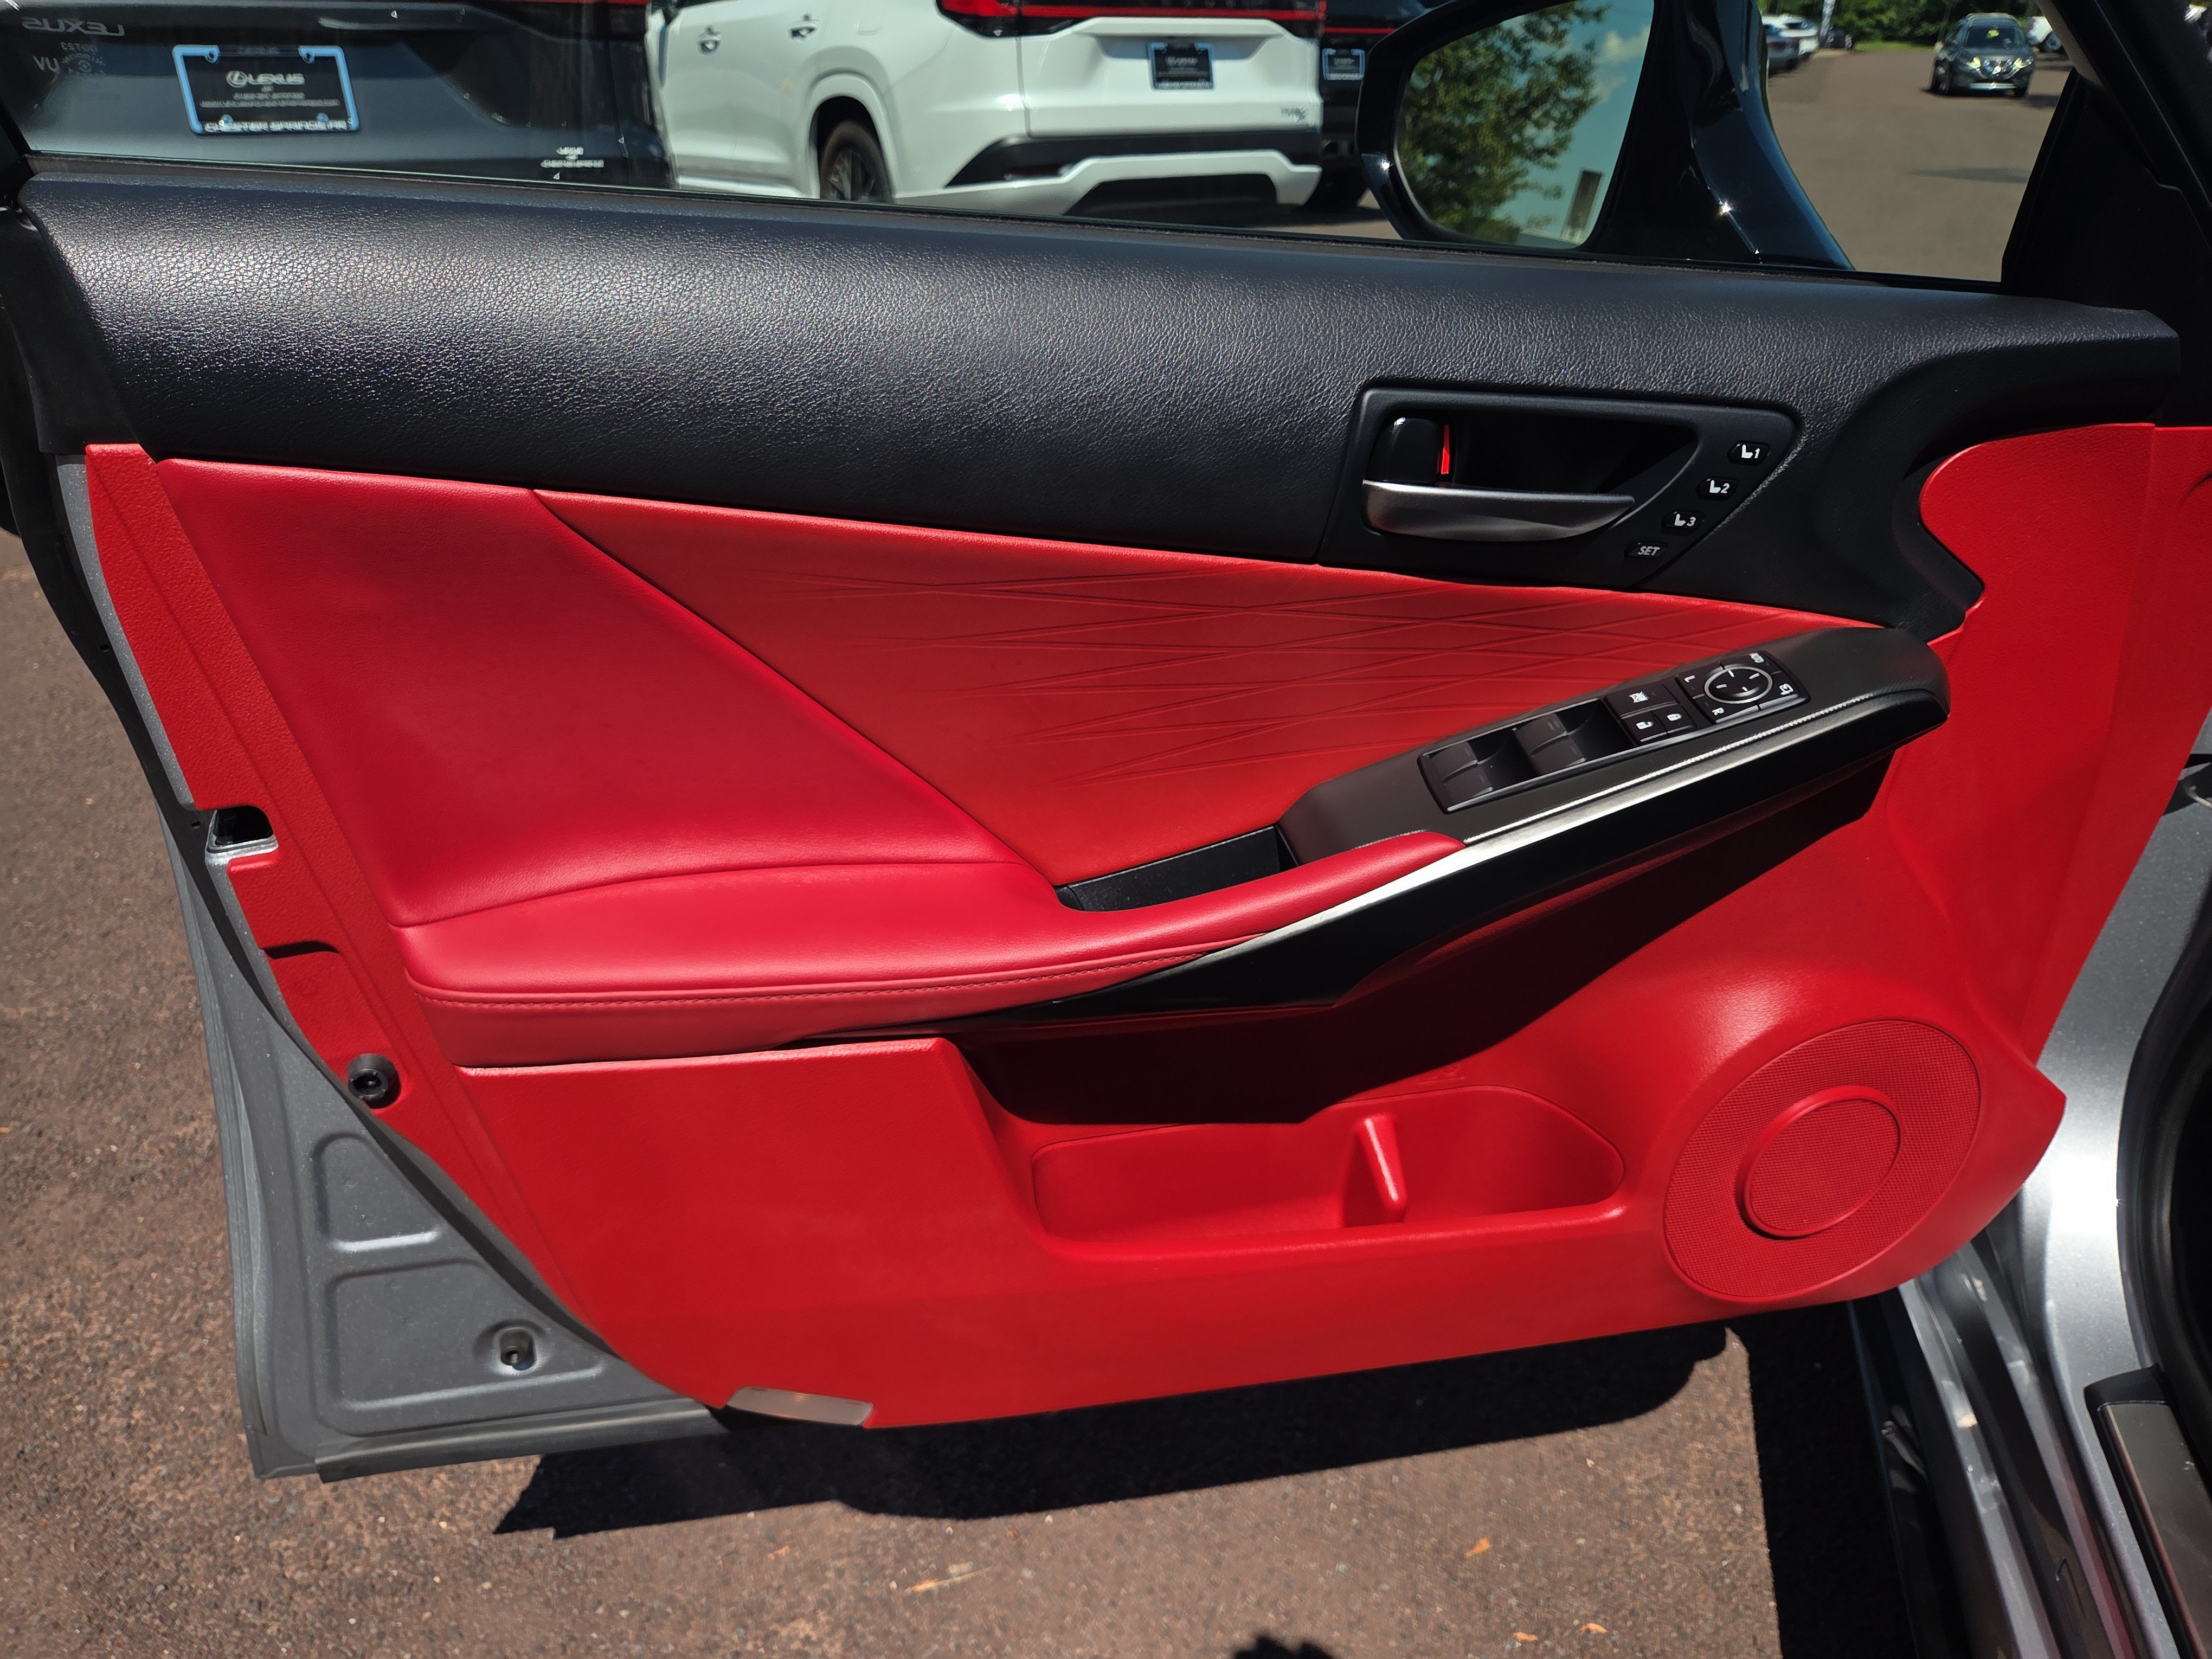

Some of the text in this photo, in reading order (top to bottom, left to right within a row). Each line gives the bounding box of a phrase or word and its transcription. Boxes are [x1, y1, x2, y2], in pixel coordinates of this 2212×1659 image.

[247, 73, 305, 85] LEXUS
[1754, 448, 1760, 459] 1
[1720, 483, 1730, 494] 2
[1687, 516, 1696, 527] 3
[1637, 545, 1660, 557] SET
[1684, 675, 1696, 683] L
[1712, 707, 1724, 716] R
